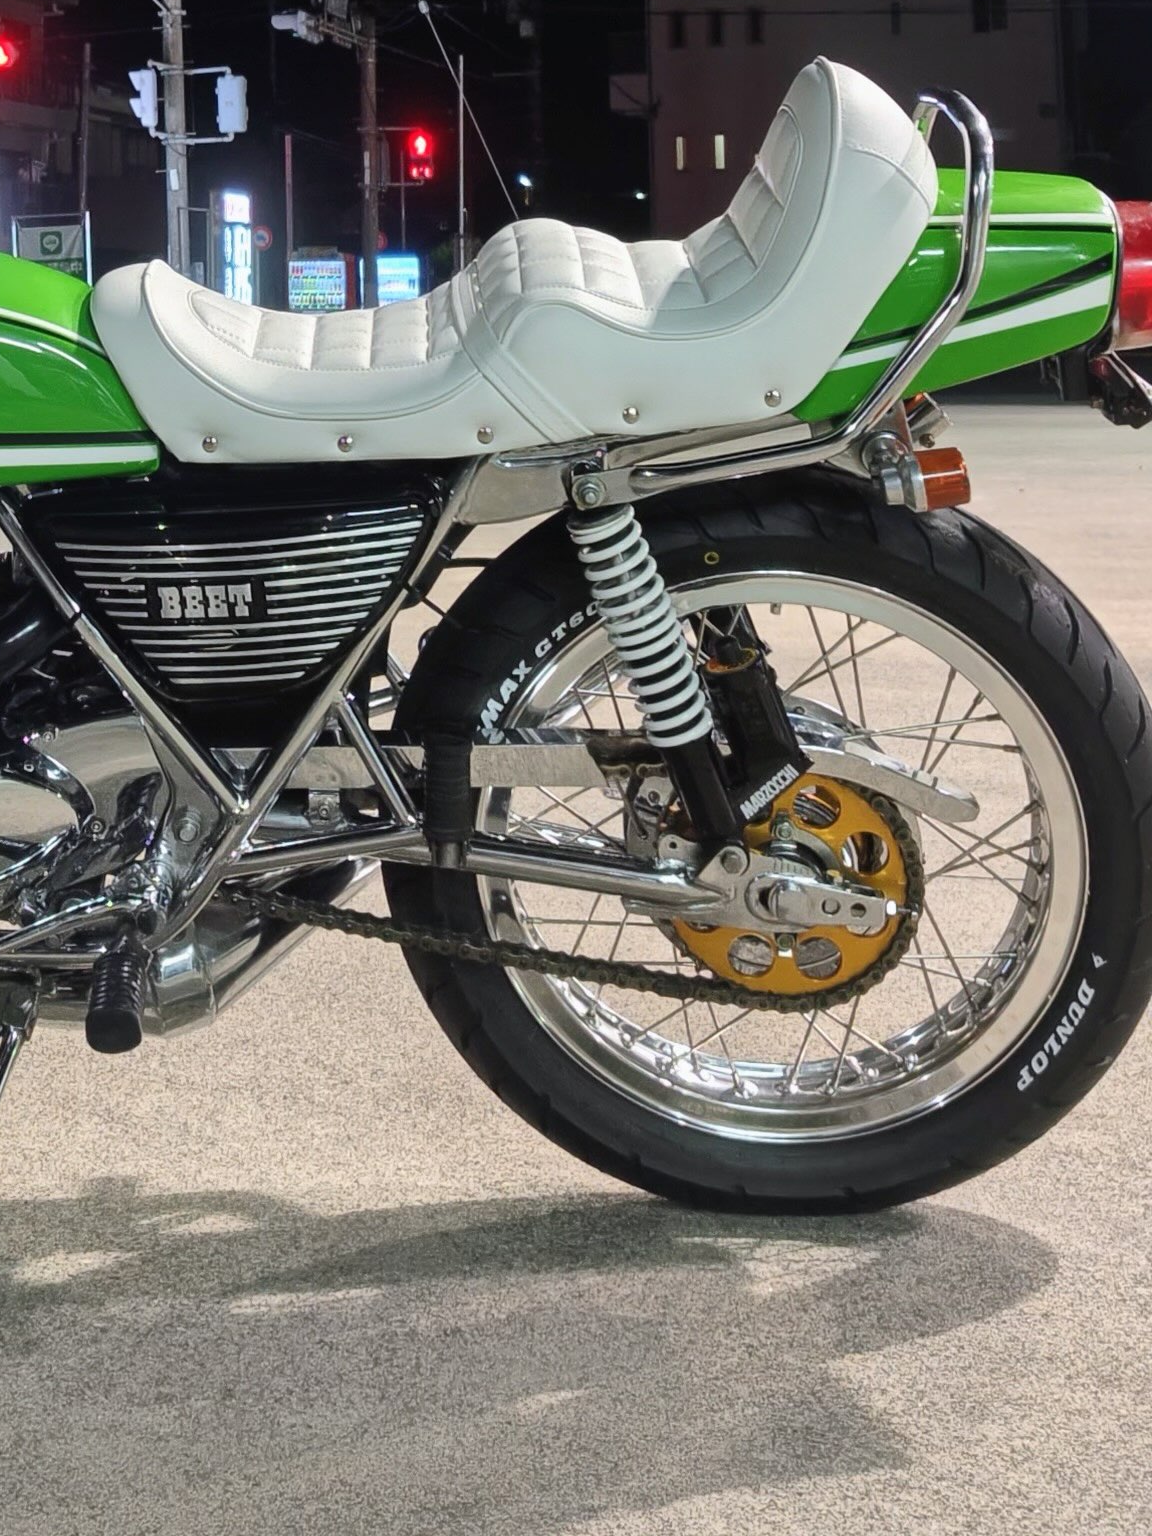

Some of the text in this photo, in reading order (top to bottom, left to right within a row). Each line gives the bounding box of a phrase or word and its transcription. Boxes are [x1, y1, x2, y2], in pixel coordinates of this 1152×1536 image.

[157, 582, 252, 619] BEET
[739, 763, 800, 820] MARZOCCHI
[1016, 977, 1096, 1091] DUNLOP
